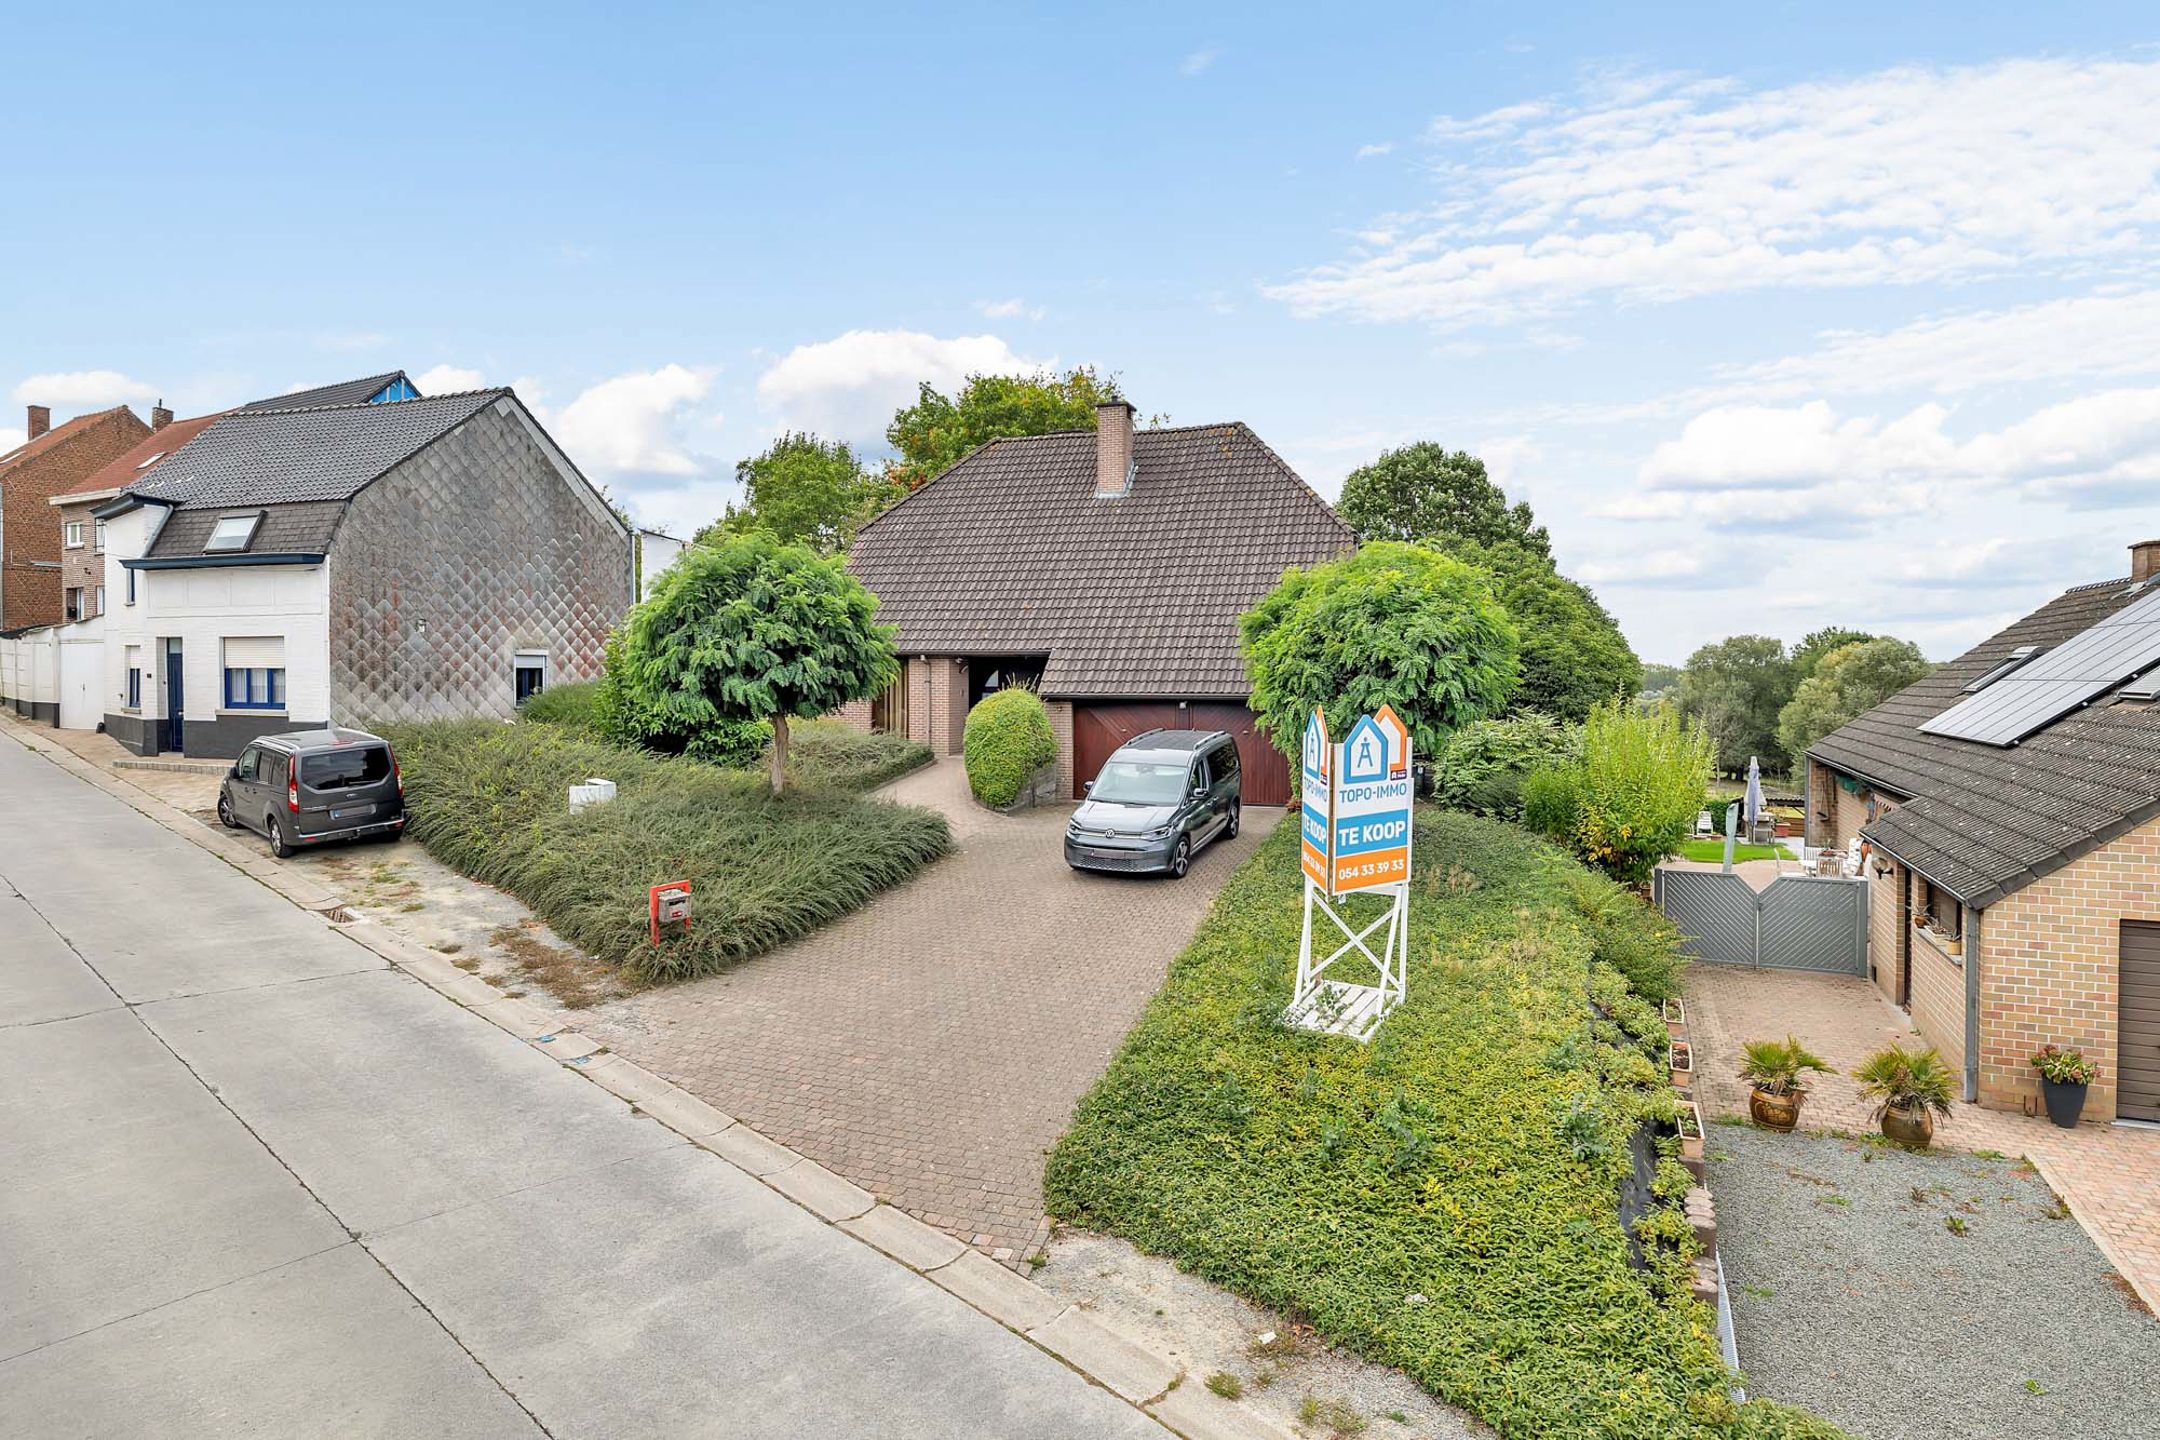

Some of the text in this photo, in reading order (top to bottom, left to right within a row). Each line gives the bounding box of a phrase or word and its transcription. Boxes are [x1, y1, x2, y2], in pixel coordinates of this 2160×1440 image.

[1339, 783, 1407, 803] TOPO-IMMO
[1339, 821, 1405, 846] TE KOOP
[1339, 860, 1404, 880] 054 33 39 33
